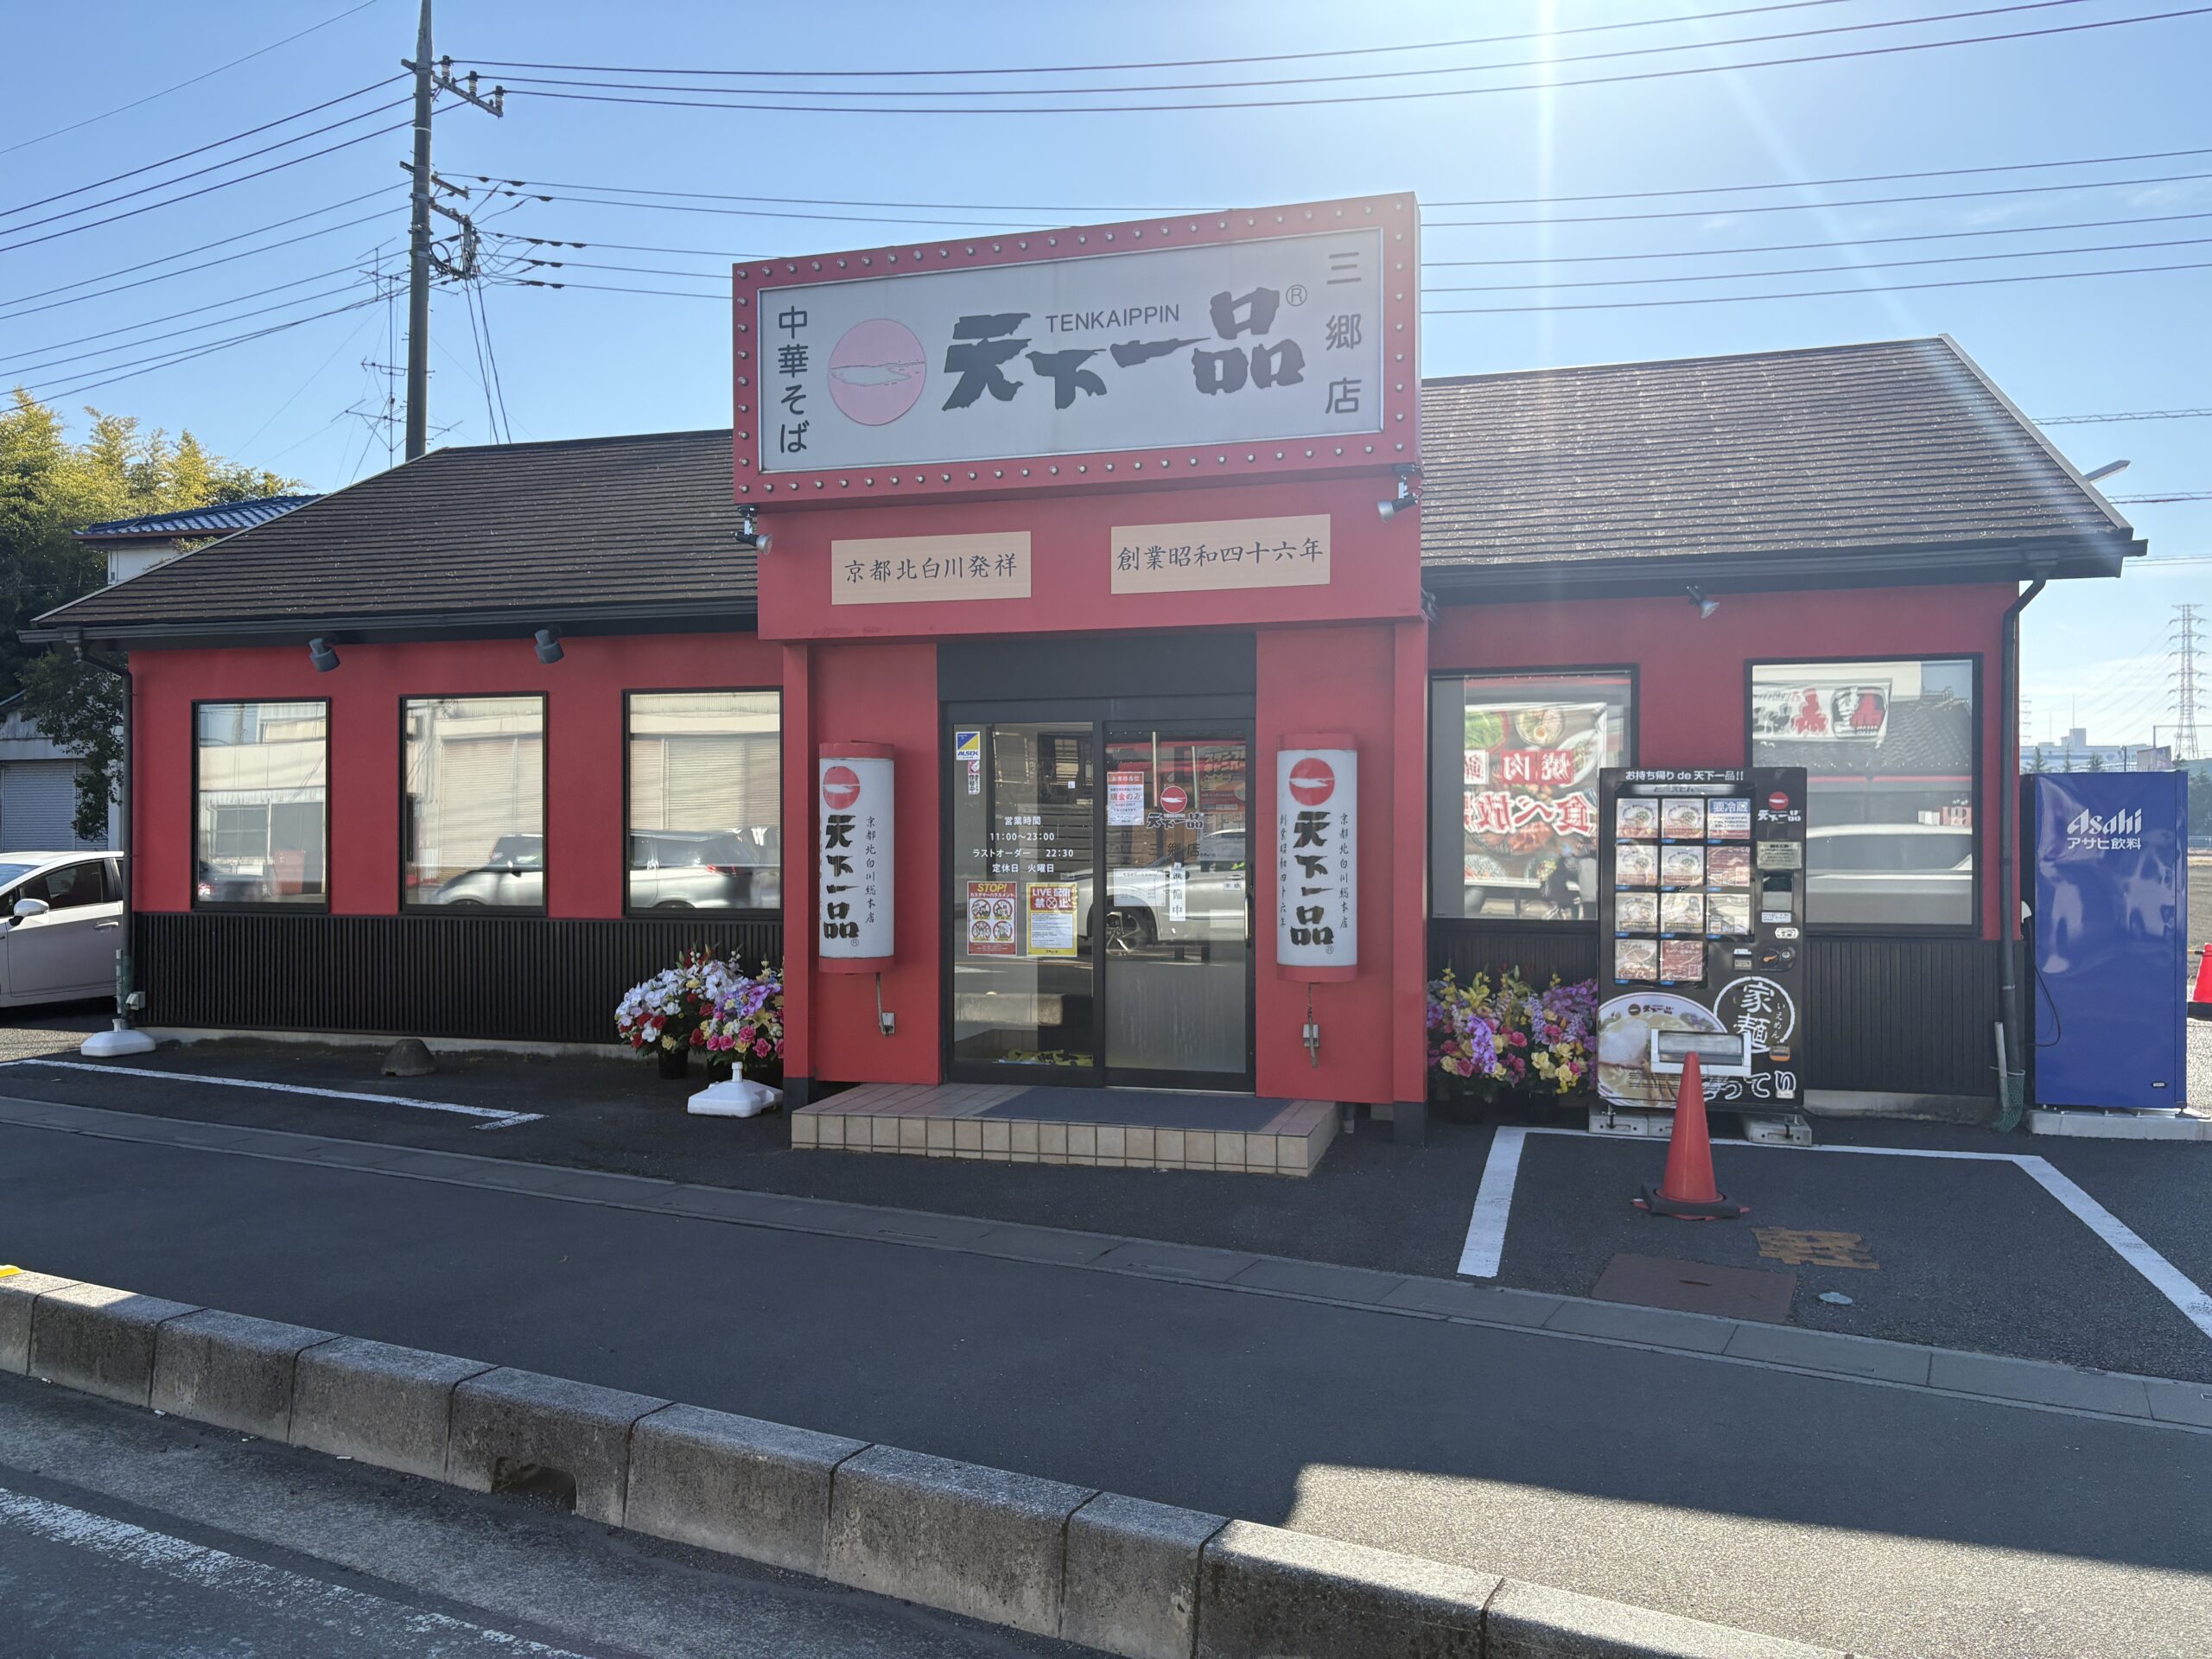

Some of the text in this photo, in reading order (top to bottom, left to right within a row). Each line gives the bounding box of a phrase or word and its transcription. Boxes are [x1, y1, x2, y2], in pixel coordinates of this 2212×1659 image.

[1046, 303, 1180, 332] TENKAIPPIN
[1325, 251, 1363, 414] 三郷店
[943, 287, 1304, 411] 天下一品
[778, 306, 809, 454] 中華そば
[1117, 537, 1324, 570] 創業昭和四十六年
[844, 553, 1018, 584] 京都北白川発祥
[1625, 771, 1674, 781] お持ち帰り
[1677, 771, 1692, 780] de
[1110, 792, 1141, 801] 現金のみ
[1713, 801, 1749, 813] 要冷蔵
[1005, 816, 1041, 826] 営業時間
[1147, 812, 1204, 829] 天下一品
[1758, 810, 1801, 822] 天下一品
[2067, 808, 2142, 835] Asahi
[1148, 843, 1200, 856] 三郷店
[2067, 837, 2142, 850] アサヒ飲料
[973, 849, 1074, 858] ラストオーダー 22:30
[823, 815, 860, 938] 天下一品
[865, 816, 876, 924] 京都北白川総本店
[992, 863, 1054, 873] 定休日 火曜日
[1339, 813, 1349, 929] 京都北白川総本店
[1291, 811, 1334, 945] 天下一品
[977, 883, 1007, 893] STOP!
[1033, 887, 1052, 896] LIVE
